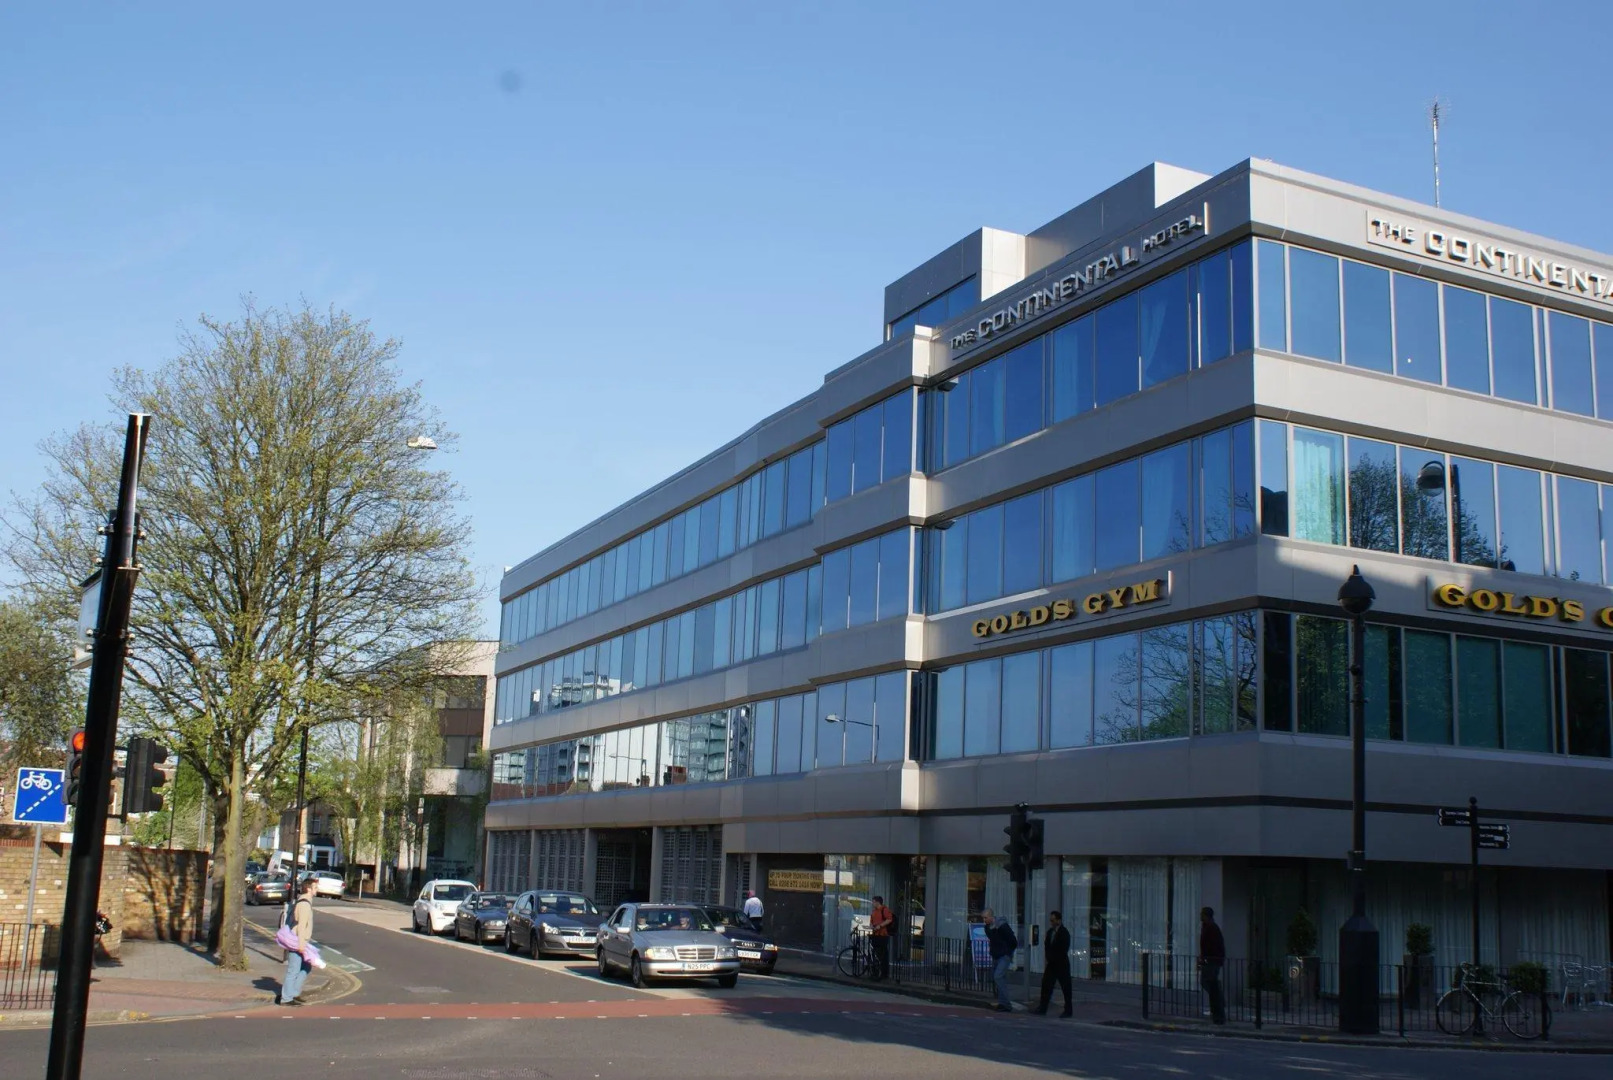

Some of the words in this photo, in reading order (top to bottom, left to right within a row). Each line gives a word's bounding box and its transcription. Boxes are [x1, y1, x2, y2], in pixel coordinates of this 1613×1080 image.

[1371, 218, 1416, 244] THE
[950, 327, 977, 349] THE
[977, 245, 1139, 339] CONTINENTAL
[1142, 214, 1203, 252] HOTEL
[1083, 578, 1163, 615] GYM
